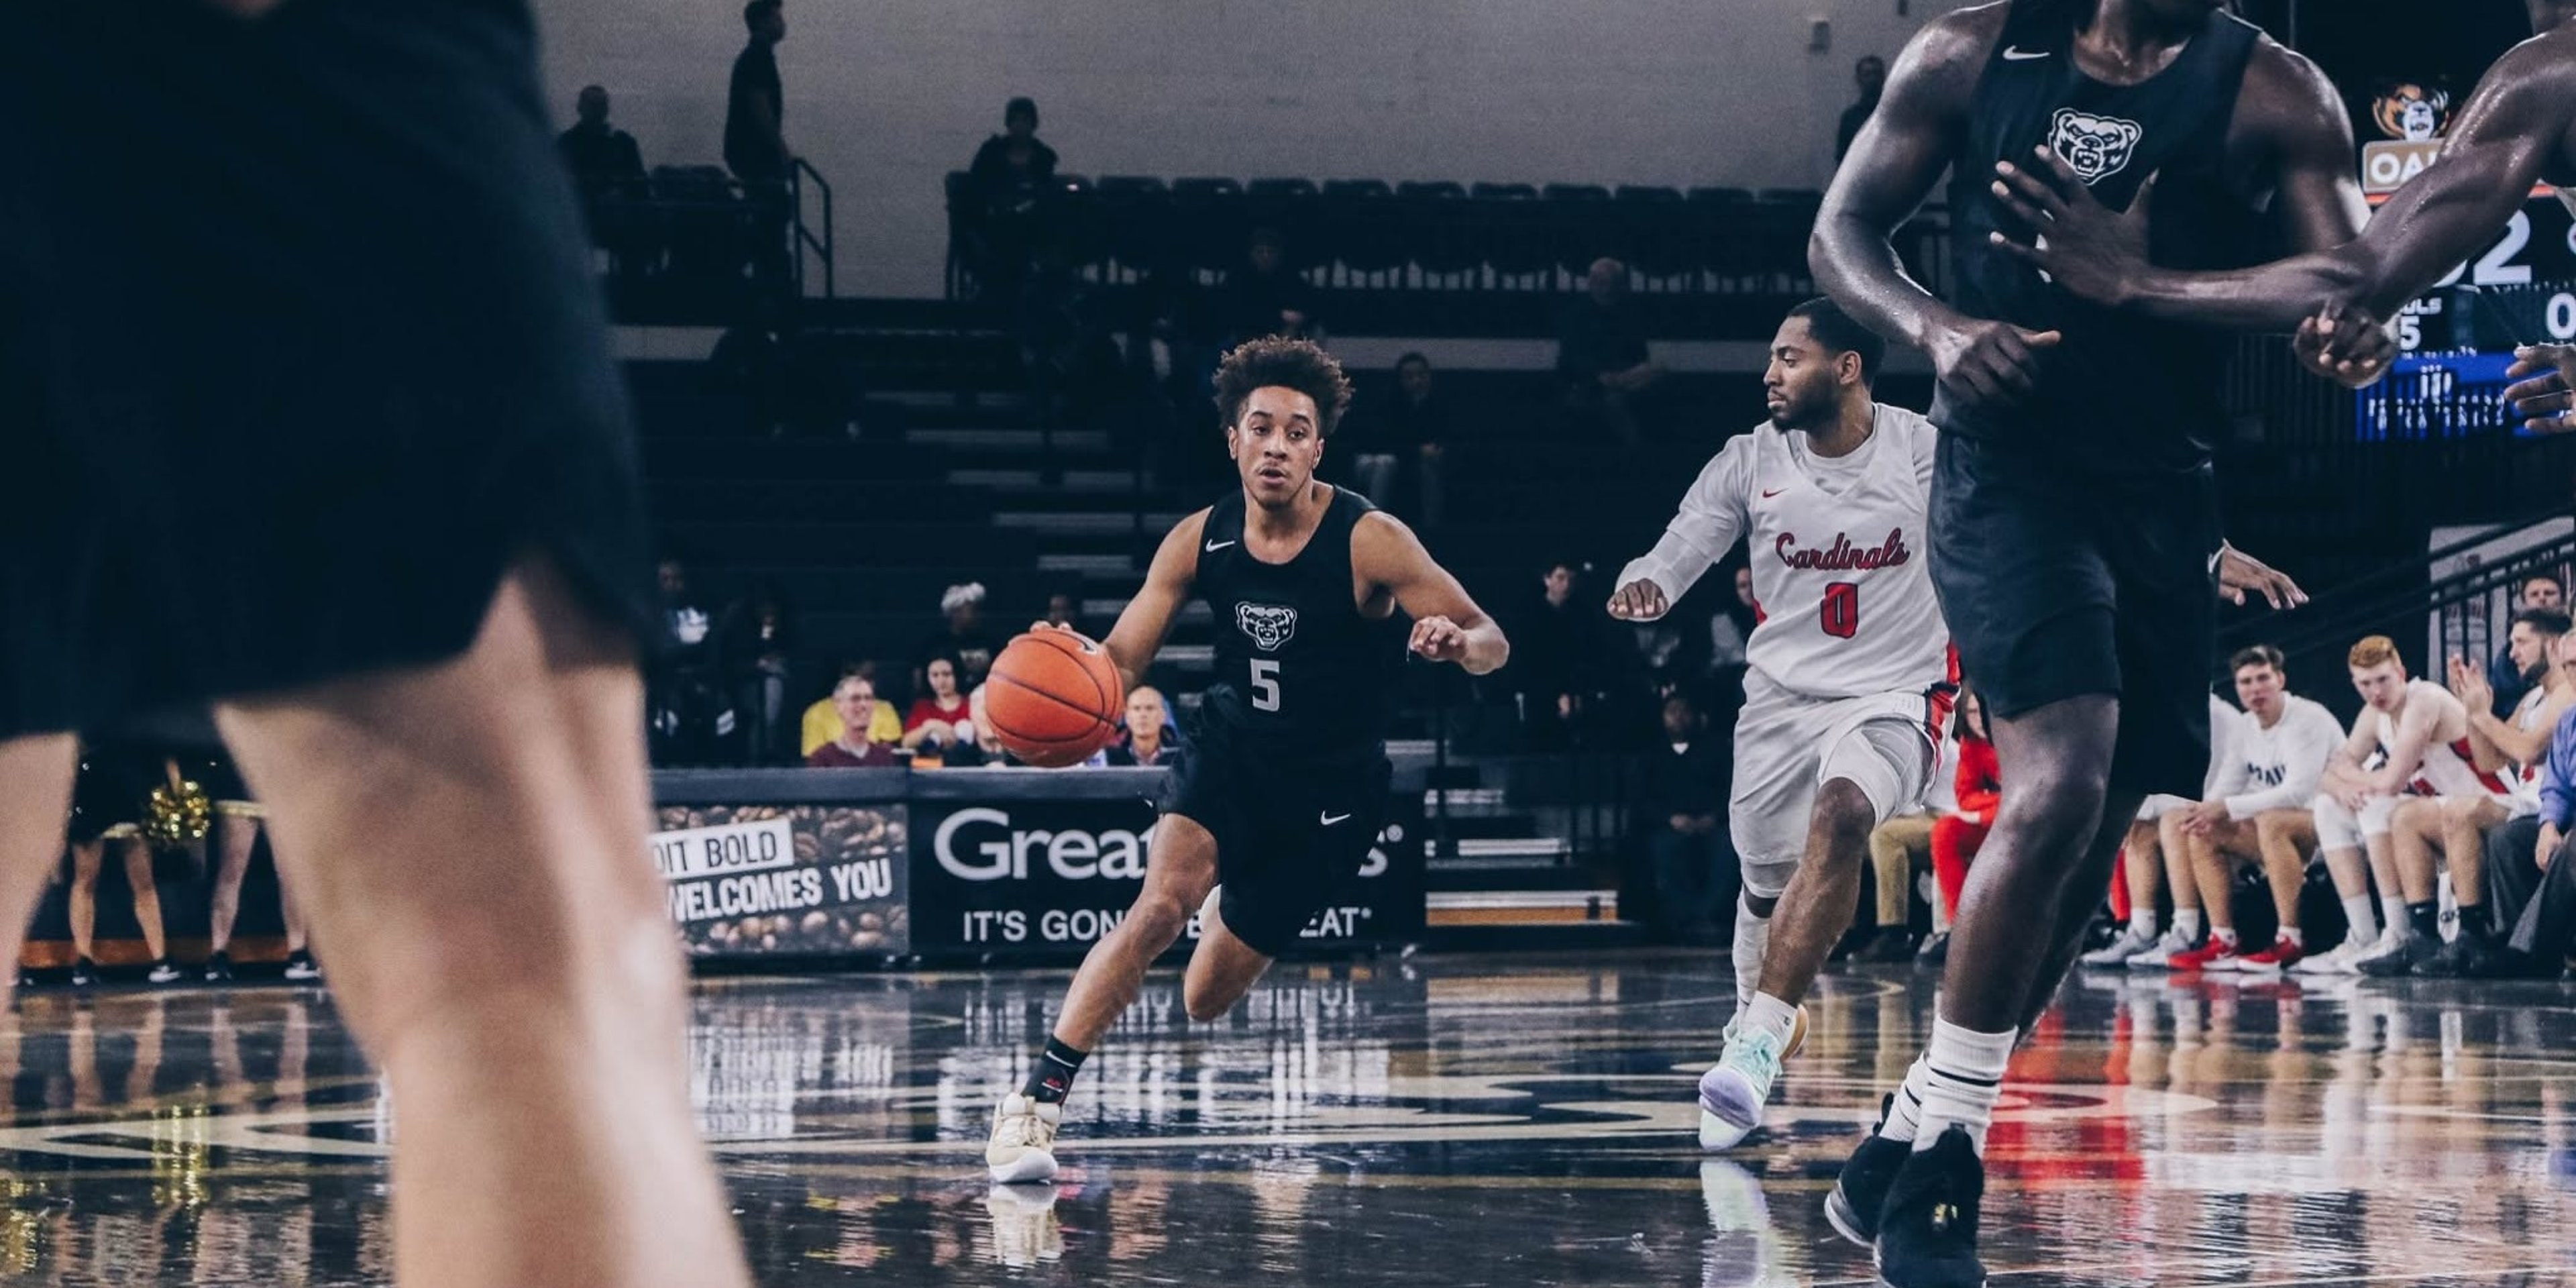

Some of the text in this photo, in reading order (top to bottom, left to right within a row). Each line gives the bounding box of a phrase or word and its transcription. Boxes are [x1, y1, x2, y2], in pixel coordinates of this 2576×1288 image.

[2432, 209, 2532, 288] 2
[1776, 527, 1911, 570] Cardinals
[1820, 581, 1859, 639] 0
[1250, 658, 1281, 712] 5
[705, 831, 777, 868] BOLD
[830, 857, 893, 903] YOU
[963, 910, 1028, 942] IT'S
